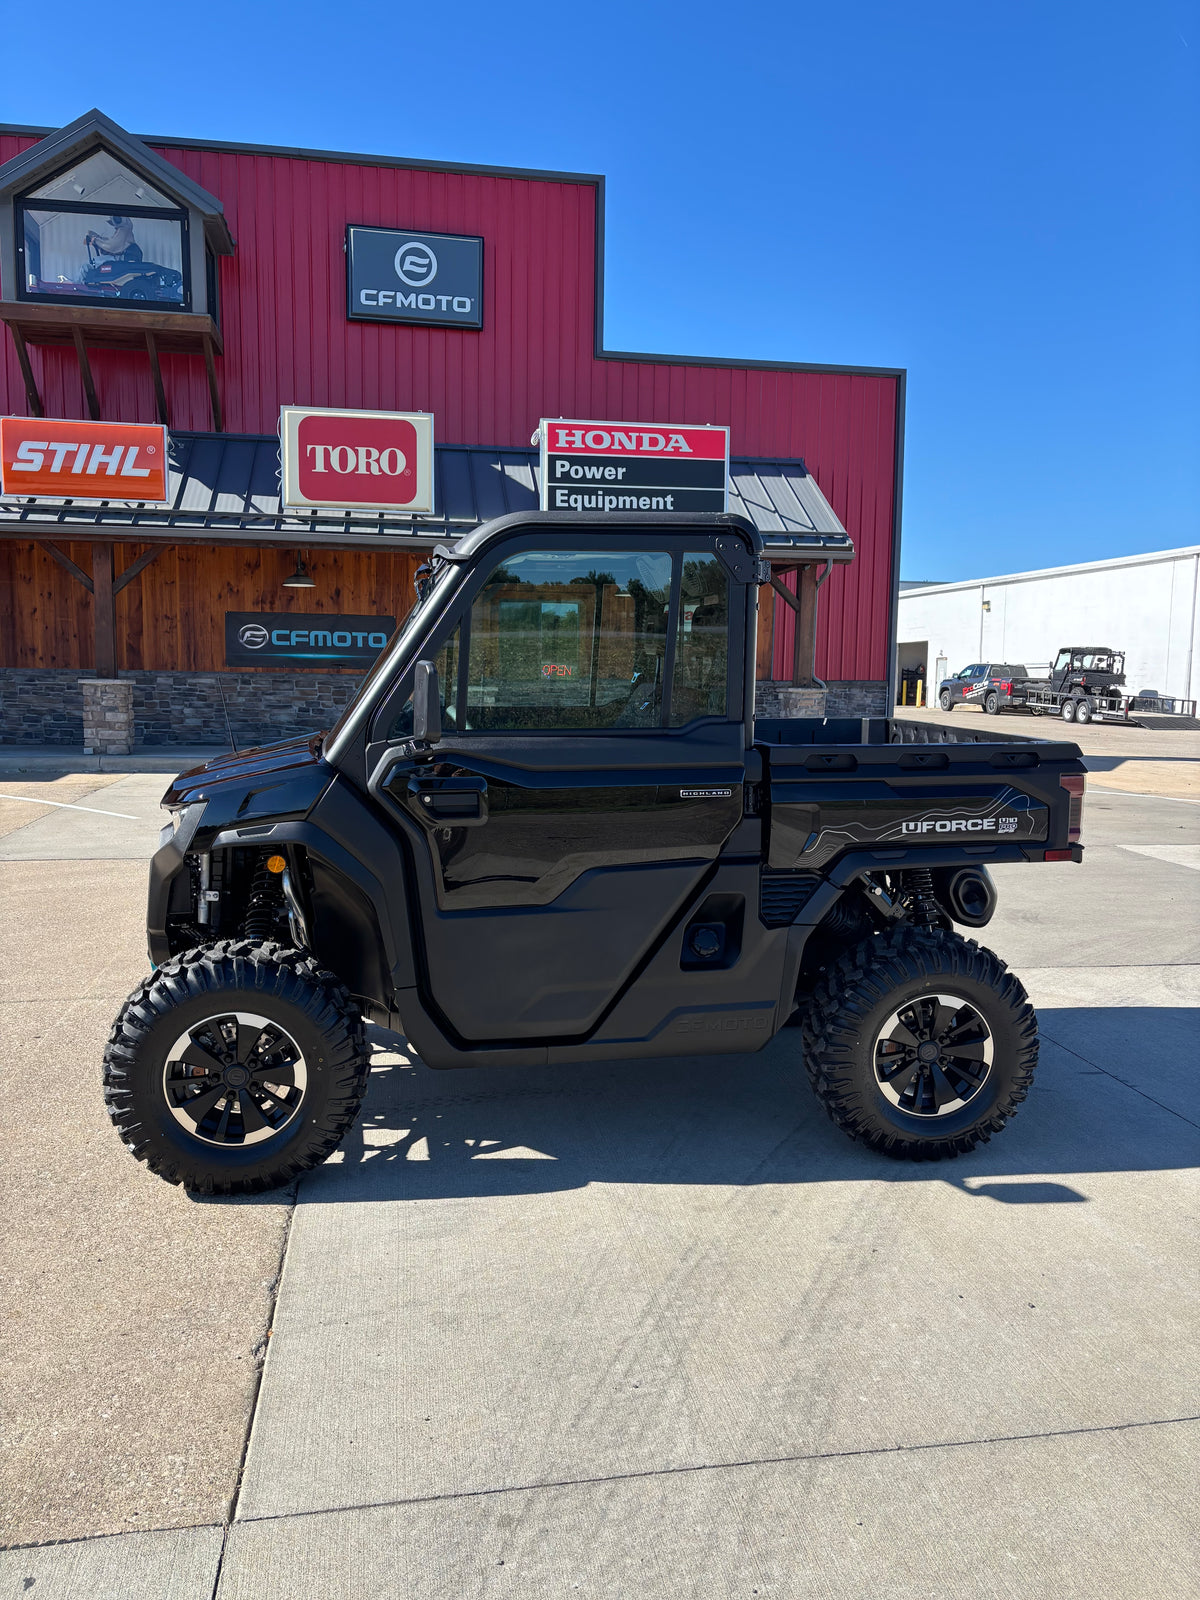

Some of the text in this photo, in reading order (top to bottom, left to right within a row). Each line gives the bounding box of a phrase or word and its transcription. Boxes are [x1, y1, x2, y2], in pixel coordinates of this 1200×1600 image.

[360, 289, 471, 313] CFMOTO
[555, 429, 693, 452] HONDA
[11, 440, 151, 477] STIHL
[306, 444, 407, 476] TORO
[555, 460, 626, 480] Power
[555, 489, 674, 512] Equipment
[271, 629, 388, 648] CFMOTO
[542, 665, 572, 676] OPEN
[902, 818, 996, 833] UFORCE
